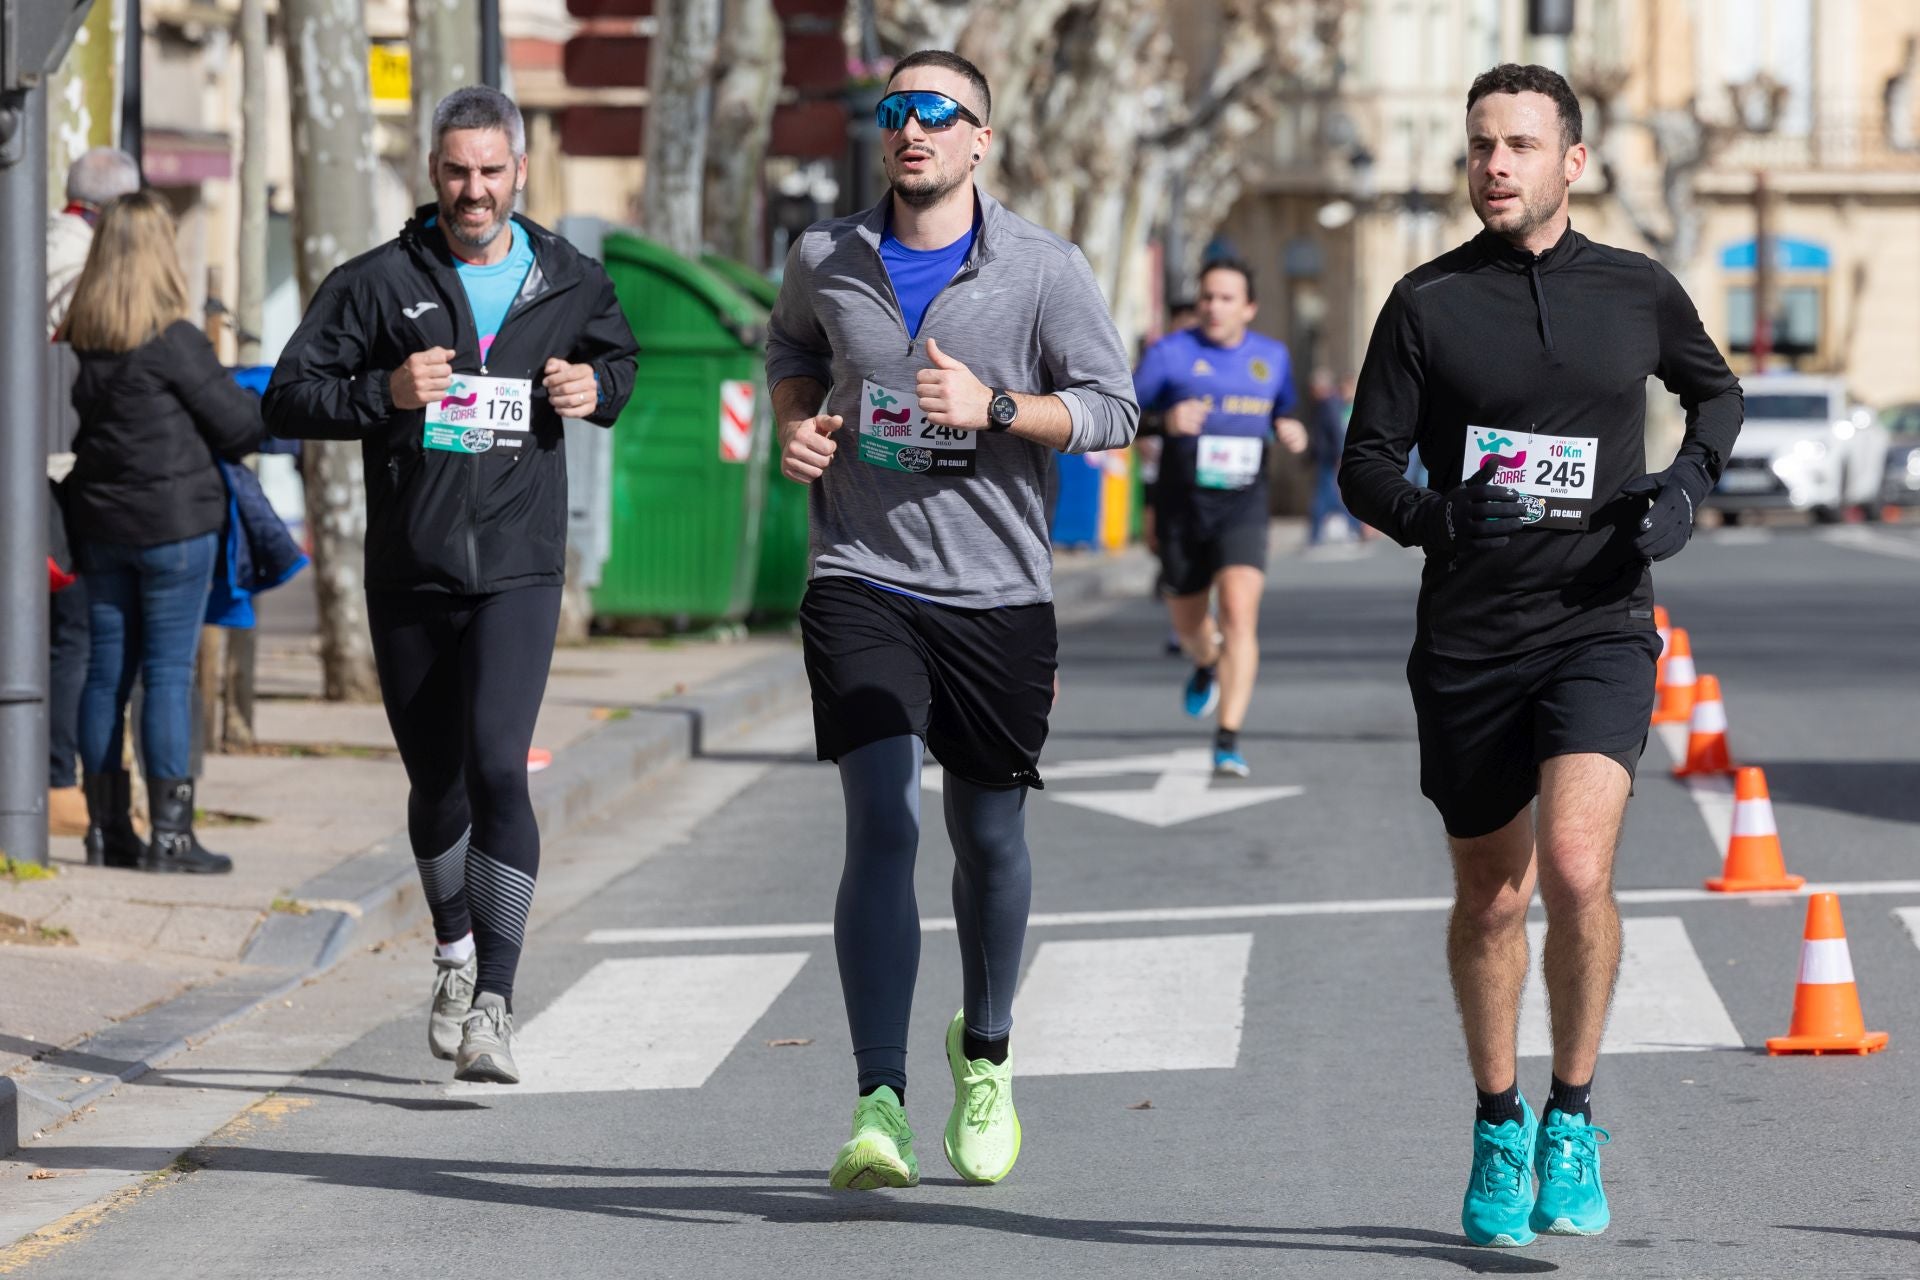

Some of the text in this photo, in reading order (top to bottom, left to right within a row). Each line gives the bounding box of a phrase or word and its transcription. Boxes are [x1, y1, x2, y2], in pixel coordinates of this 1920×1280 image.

[495, 386, 519, 396] 10Km
[451, 408, 477, 420] CORRE
[486, 399, 523, 421] 176
[872, 425, 912, 437] SE CORRE
[1549, 444, 1582, 458] 10Km
[948, 459, 968, 467] CALLE!
[1493, 469, 1527, 485] CORRE
[1534, 459, 1586, 488] 245
[1550, 509, 1582, 519] ¡TU CALLE!
